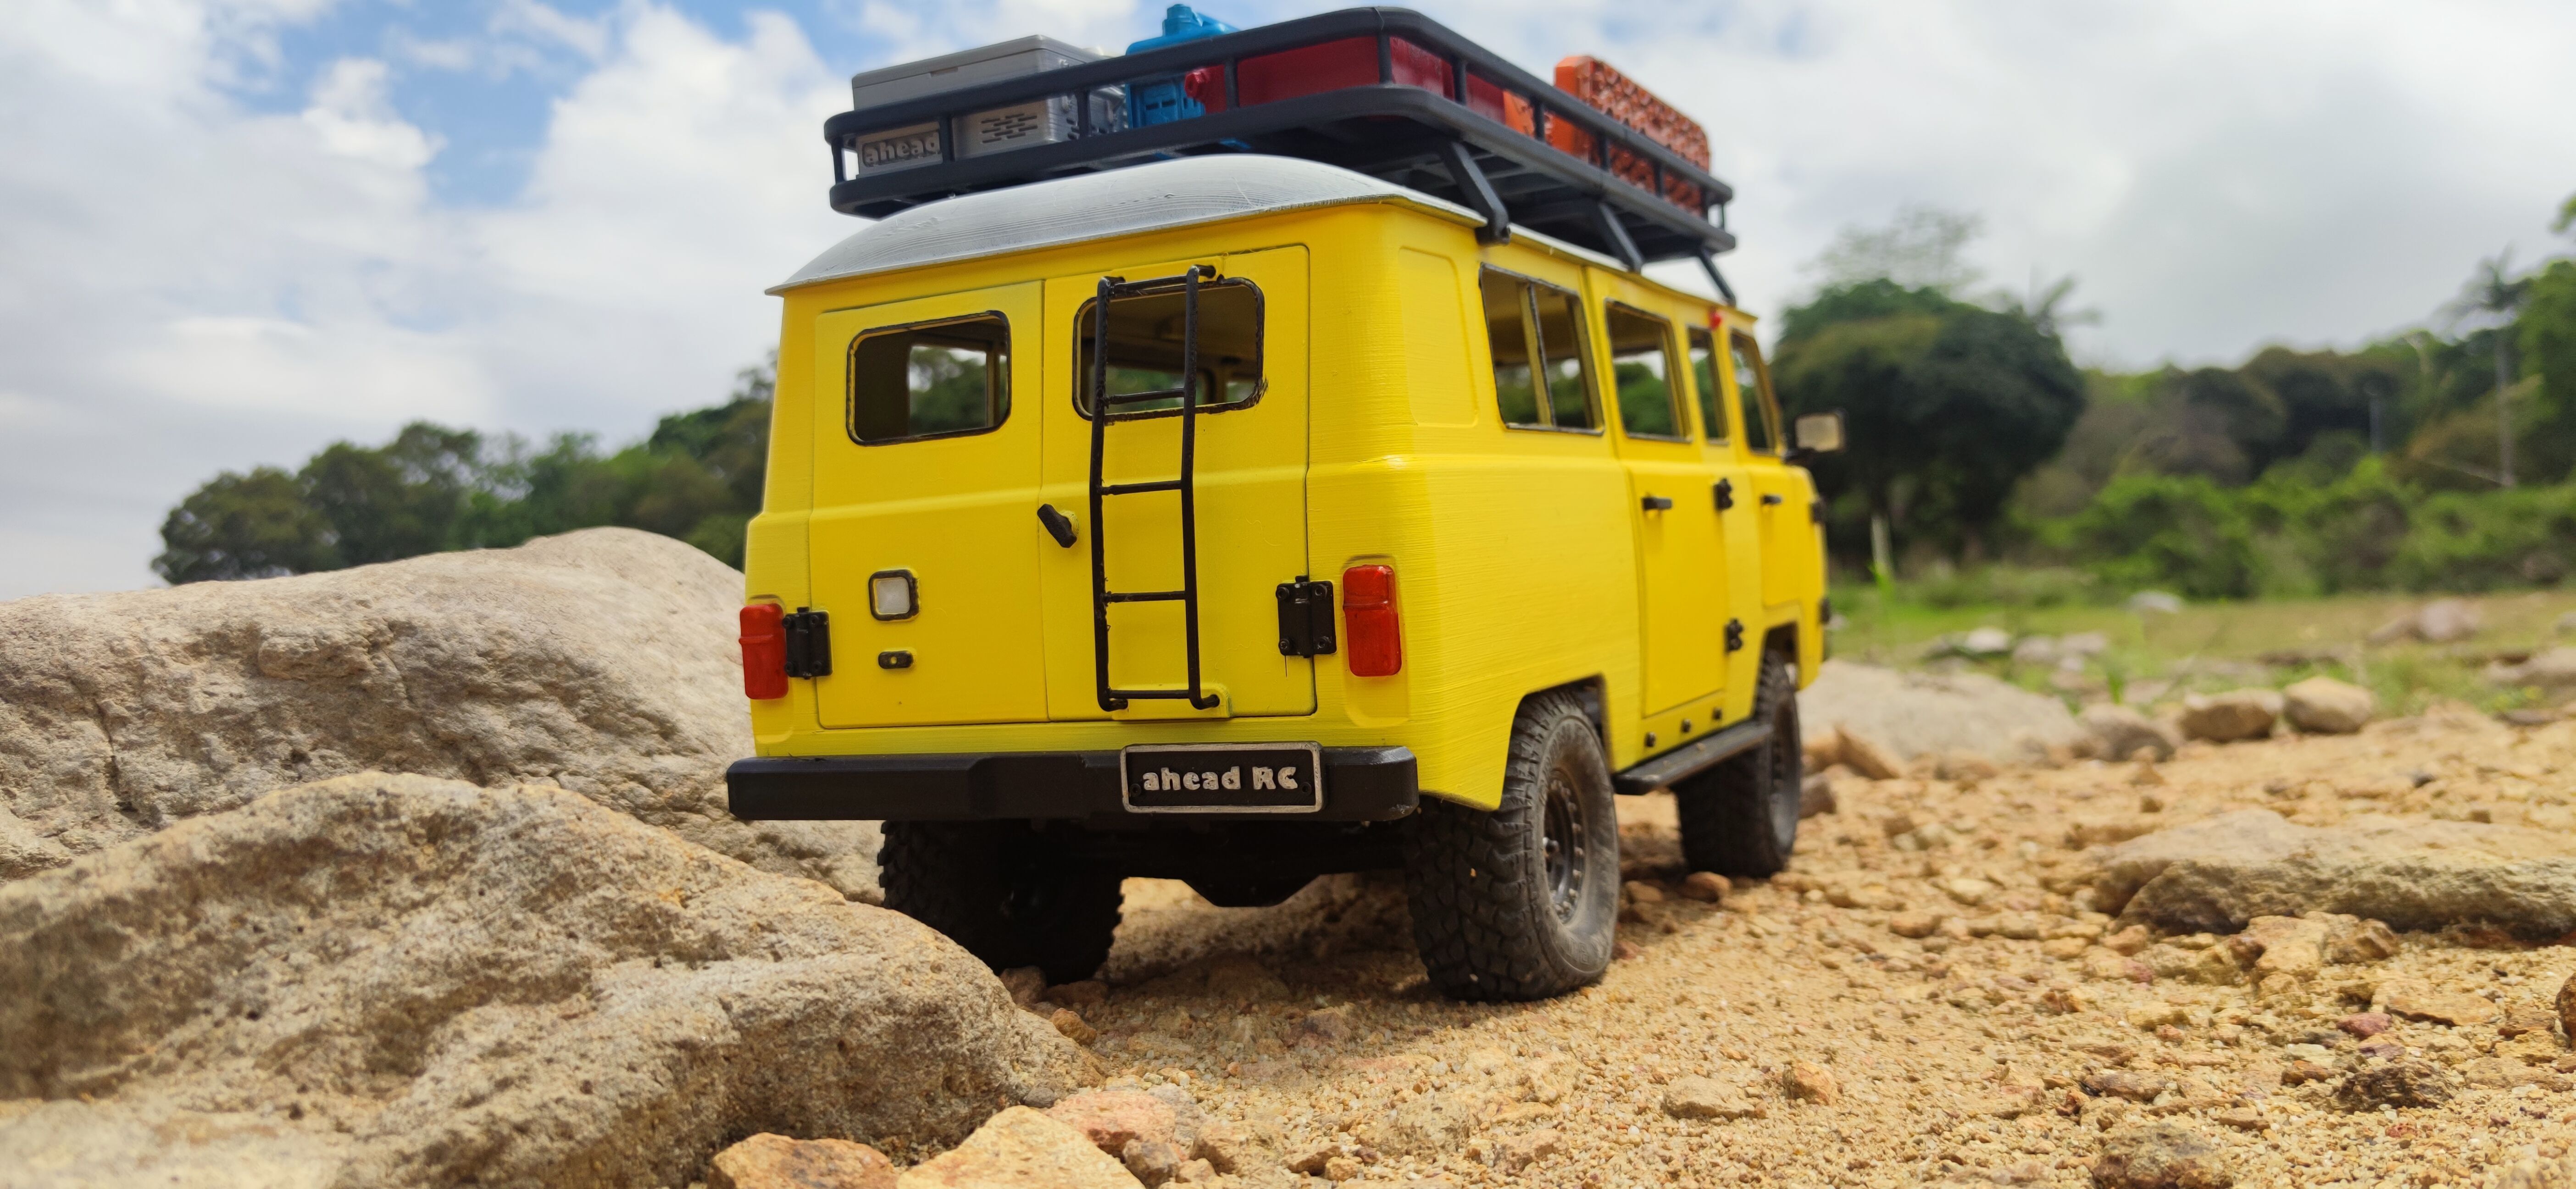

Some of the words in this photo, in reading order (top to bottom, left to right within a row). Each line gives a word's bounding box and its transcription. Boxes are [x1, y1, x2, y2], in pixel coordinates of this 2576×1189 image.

[865, 132, 940, 163] ahead
[1143, 766, 1241, 790] ahead
[1252, 766, 1298, 790] RC
